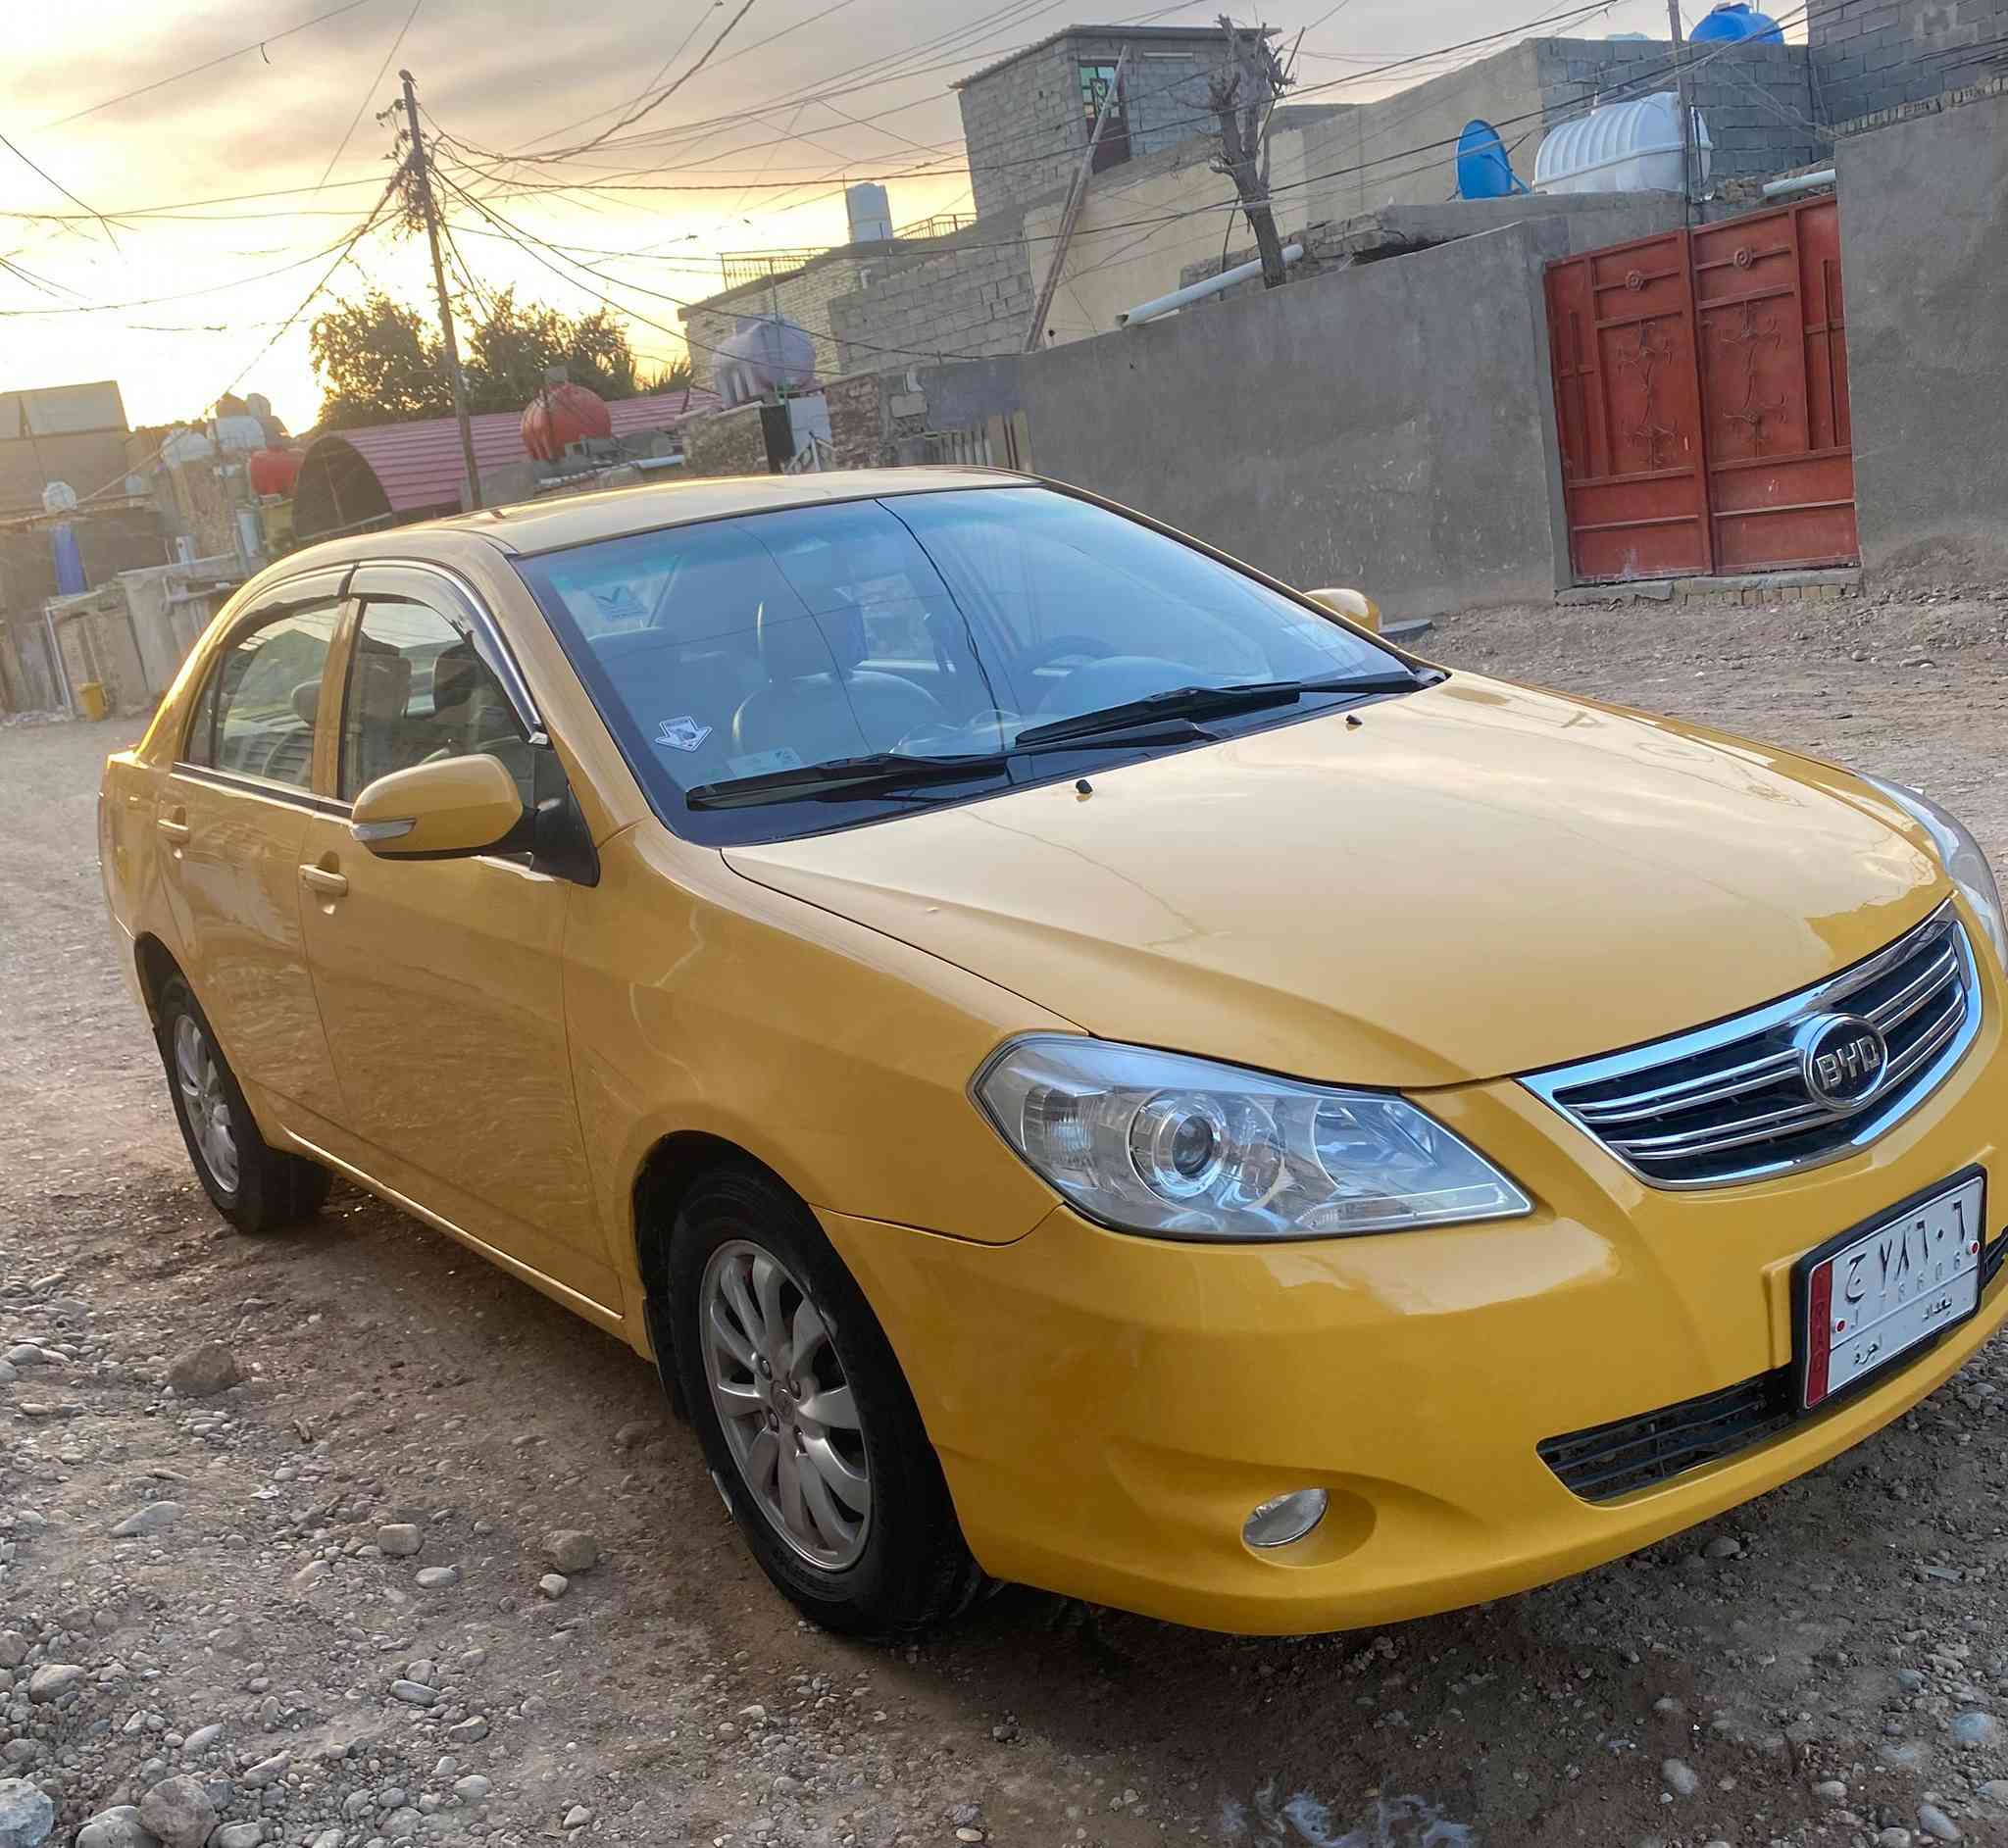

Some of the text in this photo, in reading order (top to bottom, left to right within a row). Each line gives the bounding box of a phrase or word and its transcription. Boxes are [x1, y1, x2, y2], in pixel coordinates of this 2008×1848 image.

[1816, 1035, 1881, 1090] BYD
[1844, 1200, 1965, 1304] ٧٨٦٠٦ ج
